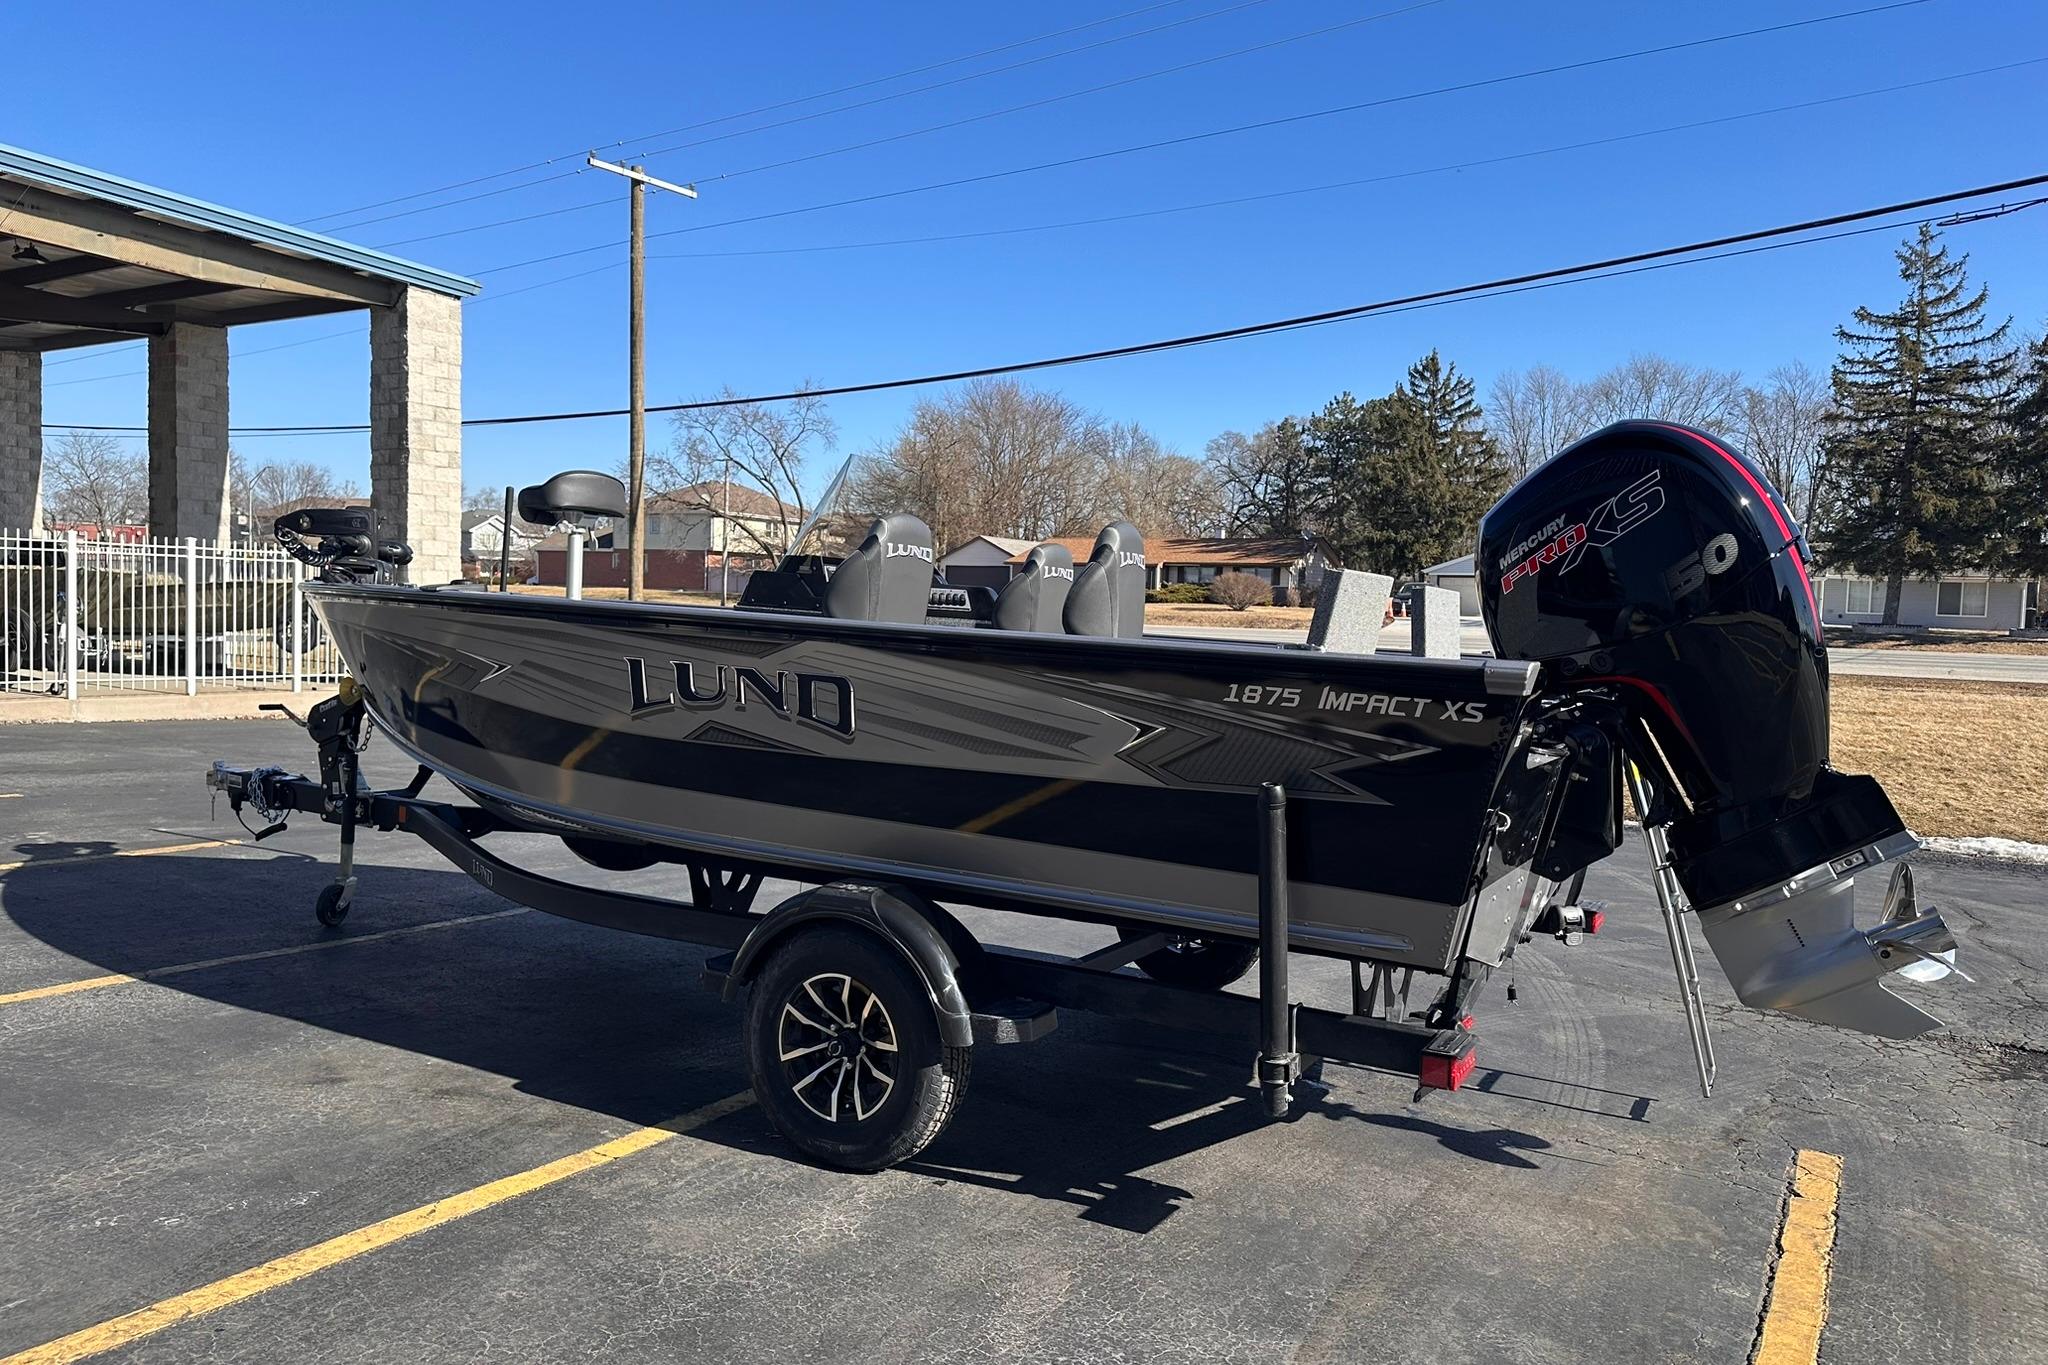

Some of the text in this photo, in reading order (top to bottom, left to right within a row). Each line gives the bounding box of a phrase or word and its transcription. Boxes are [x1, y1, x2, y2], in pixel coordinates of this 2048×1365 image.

[886, 542, 933, 564] LUND
[1500, 513, 1566, 569] MERCURY
[1043, 565, 1074, 583] LUND
[624, 656, 857, 739] LUND
[1224, 683, 1302, 707] 1875
[1440, 701, 1486, 723] XS
